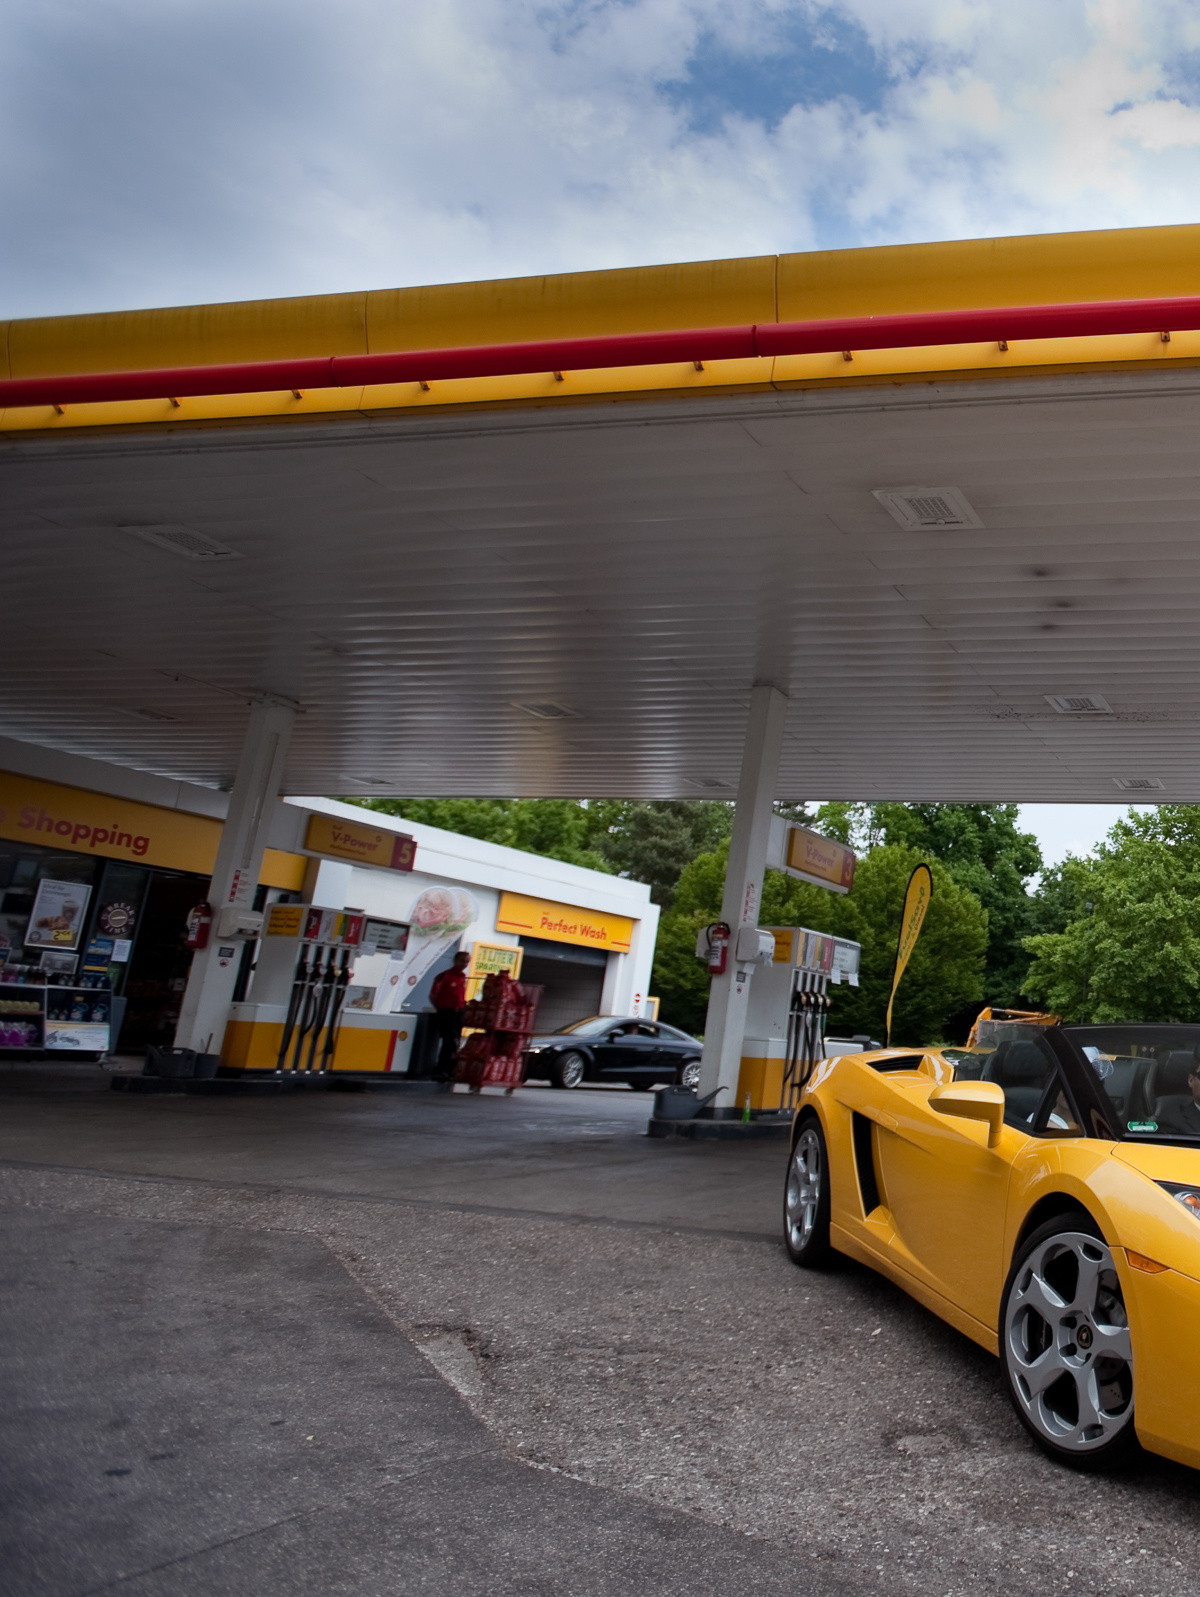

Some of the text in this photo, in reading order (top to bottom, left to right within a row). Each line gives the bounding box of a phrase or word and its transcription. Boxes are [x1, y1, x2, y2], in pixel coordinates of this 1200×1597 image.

[18, 806, 150, 856] Shopping
[331, 831, 378, 852] V-Power
[398, 842, 413, 865] 5
[844, 857, 853, 881] 3
[107, 902, 135, 916] BREAK
[104, 924, 126, 934] TIME
[540, 916, 608, 940] Perfect Wash
